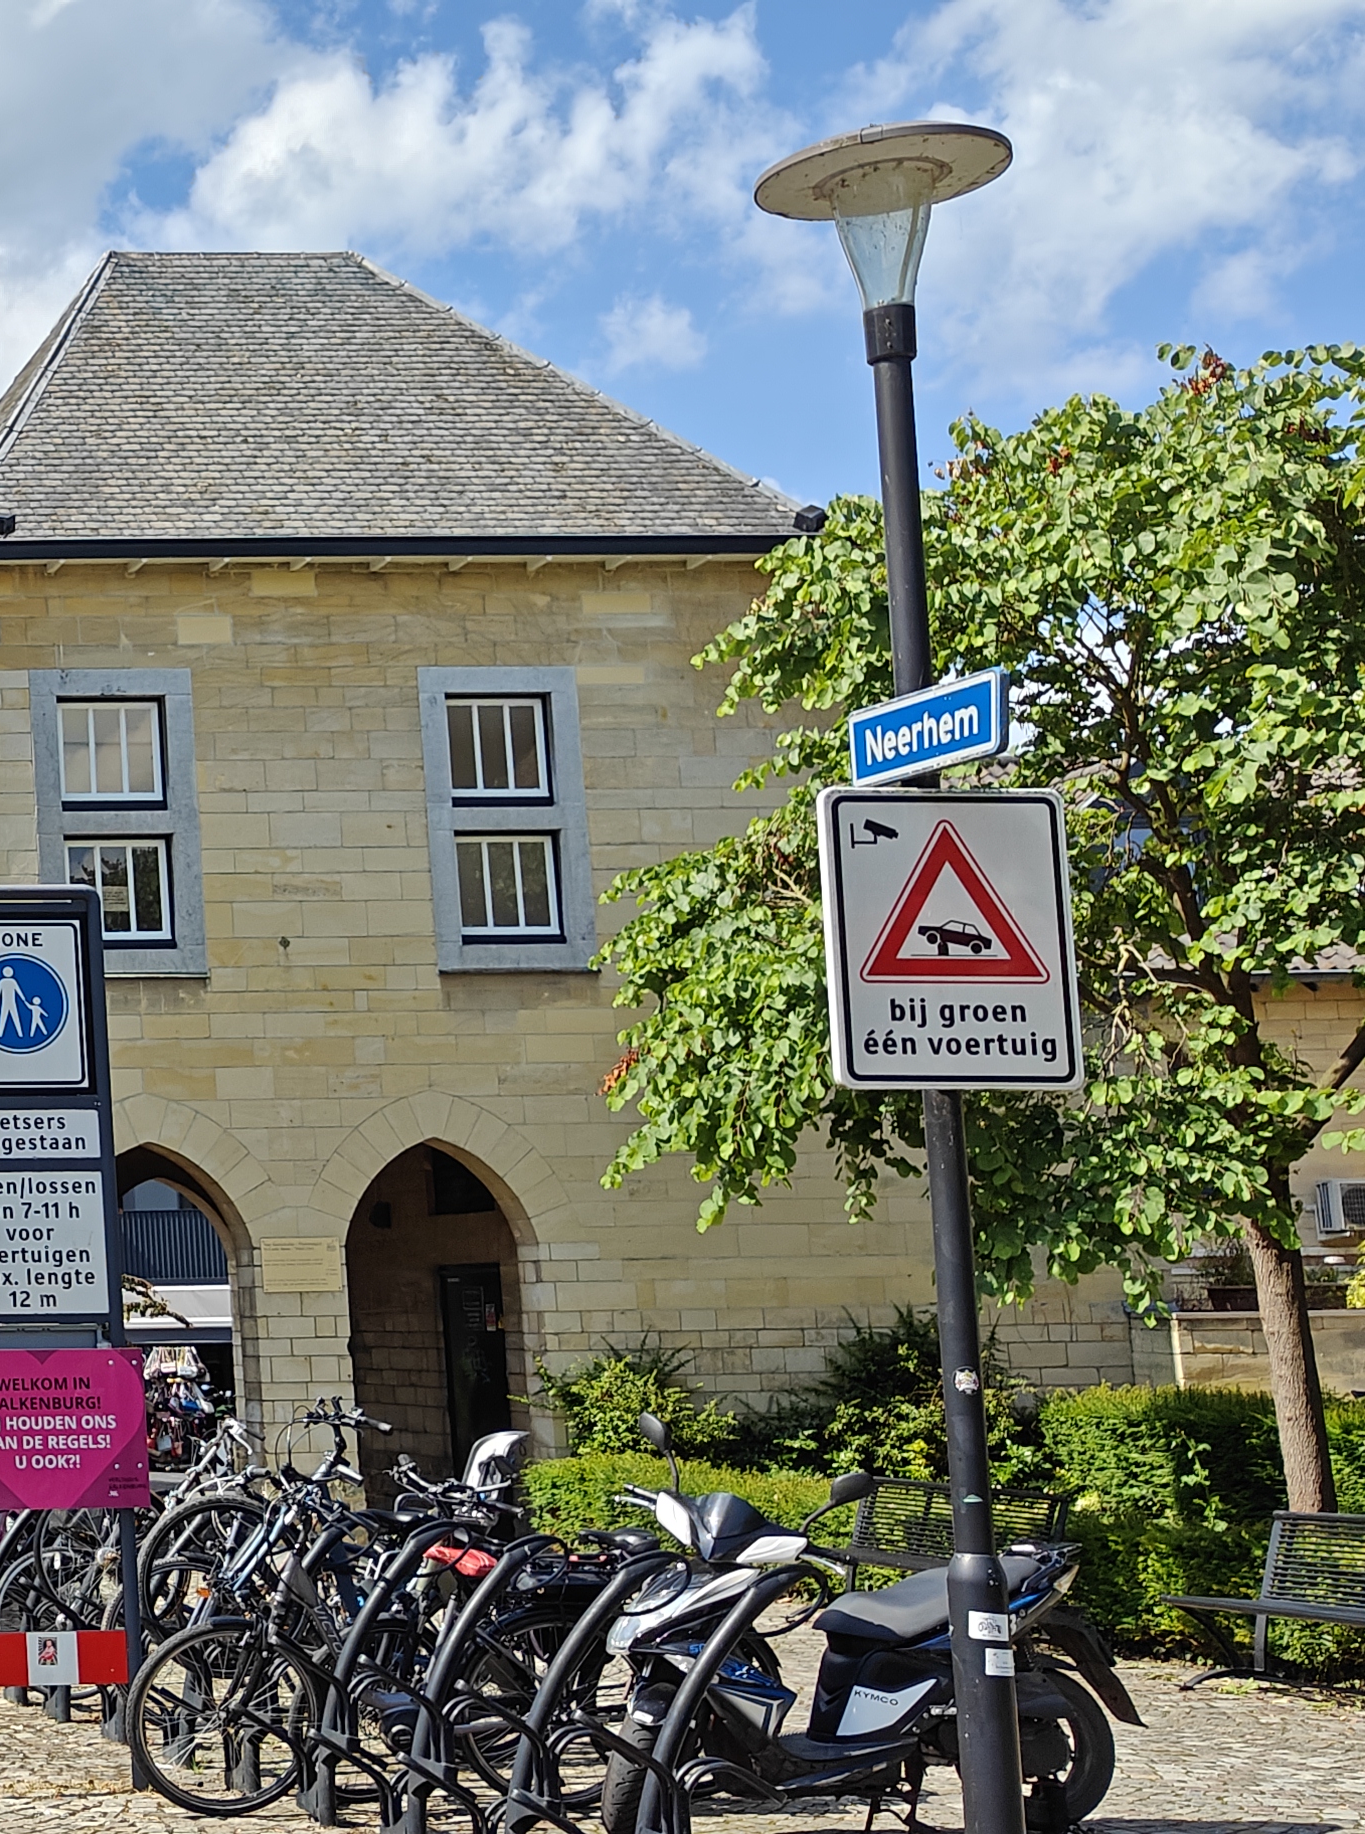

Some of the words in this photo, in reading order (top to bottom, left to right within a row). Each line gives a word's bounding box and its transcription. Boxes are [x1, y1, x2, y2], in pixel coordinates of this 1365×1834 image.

[865, 704, 979, 766] Neerhem
[889, 997, 928, 1029] bij
[939, 1004, 1027, 1029] groen
[863, 1029, 917, 1056] één
[927, 1031, 1058, 1063] voertuig
[21, 1202, 60, 1219] 7-11
[69, 1201, 80, 1218] h
[6, 1227, 55, 1241] voor
[27, 1268, 96, 1289] lengte
[9, 1291, 31, 1307] 12
[40, 1293, 57, 1307] m
[73, 1376, 90, 1390] IN
[6, 1415, 76, 1430] HOUDEN
[81, 1414, 116, 1429] ONS
[22, 1435, 43, 1449] DE
[48, 1434, 111, 1449] REGELS!
[14, 1455, 27, 1469] U
[31, 1454, 80, 1469] OOK?!
[854, 1690, 899, 1706] KYMCO
